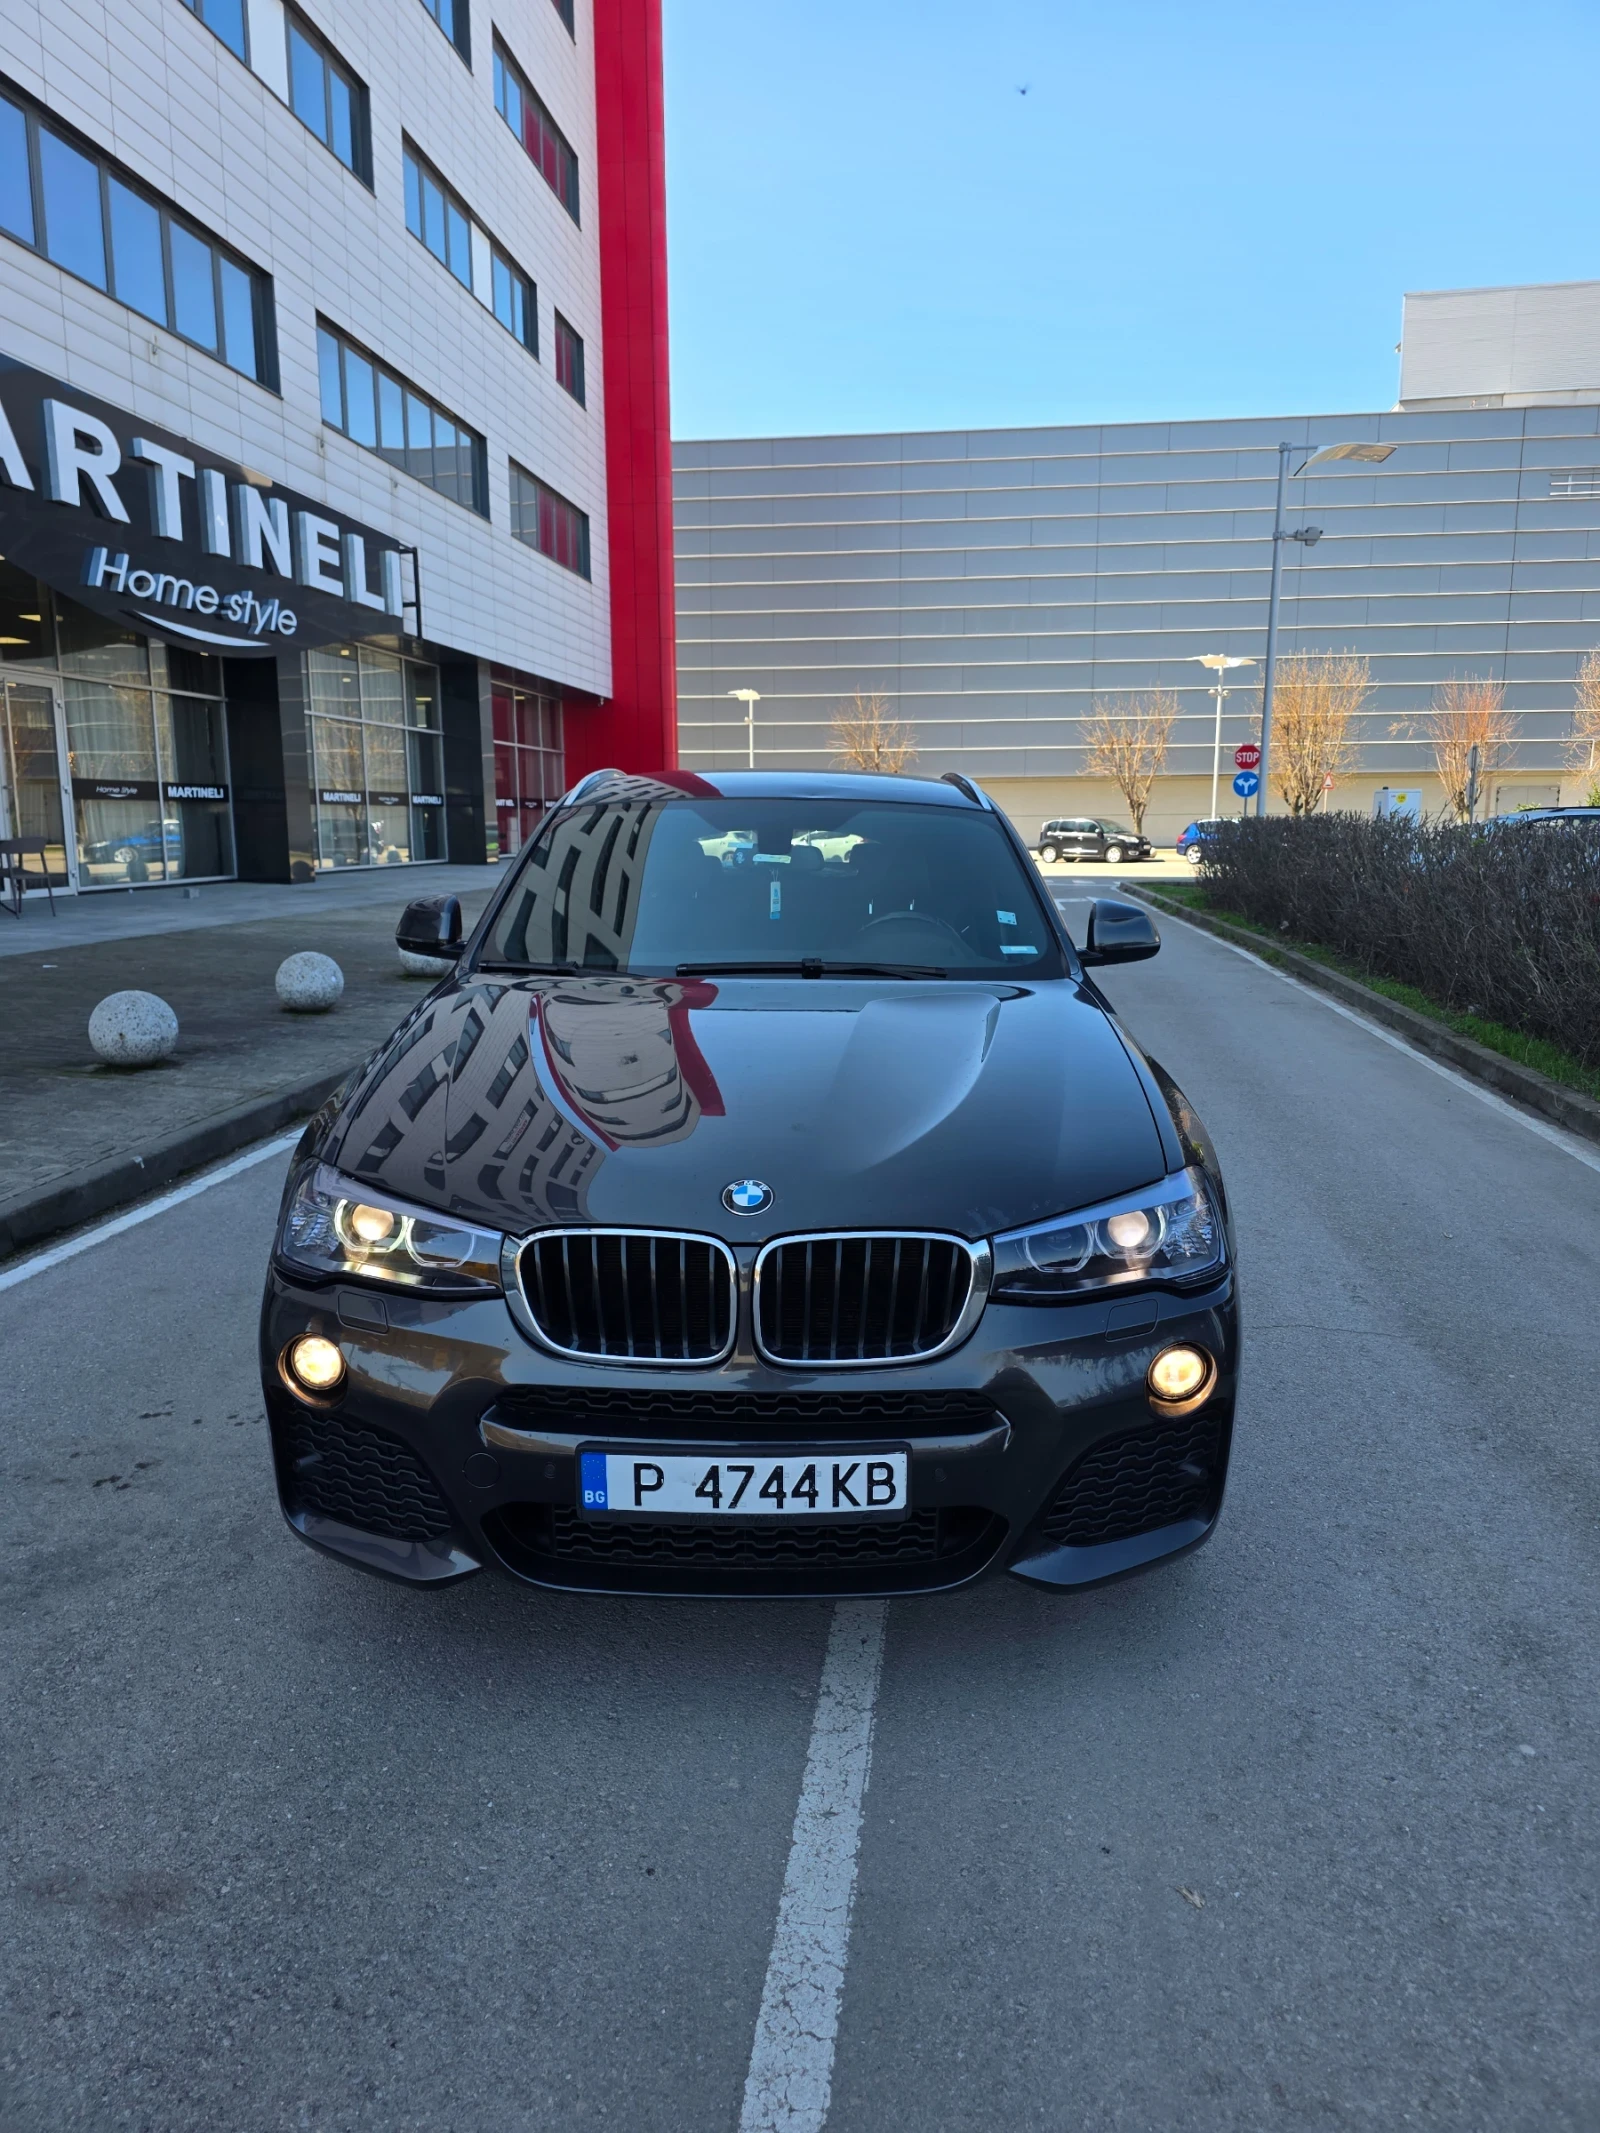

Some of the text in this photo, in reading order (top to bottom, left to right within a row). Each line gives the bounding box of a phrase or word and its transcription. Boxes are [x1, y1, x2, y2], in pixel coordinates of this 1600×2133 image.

[90, 546, 298, 636] Home style
[1236, 751, 1260, 763] STOP
[167, 786, 225, 799] MARTINELI
[633, 1462, 665, 1507] P
[584, 1489, 606, 1504] BG
